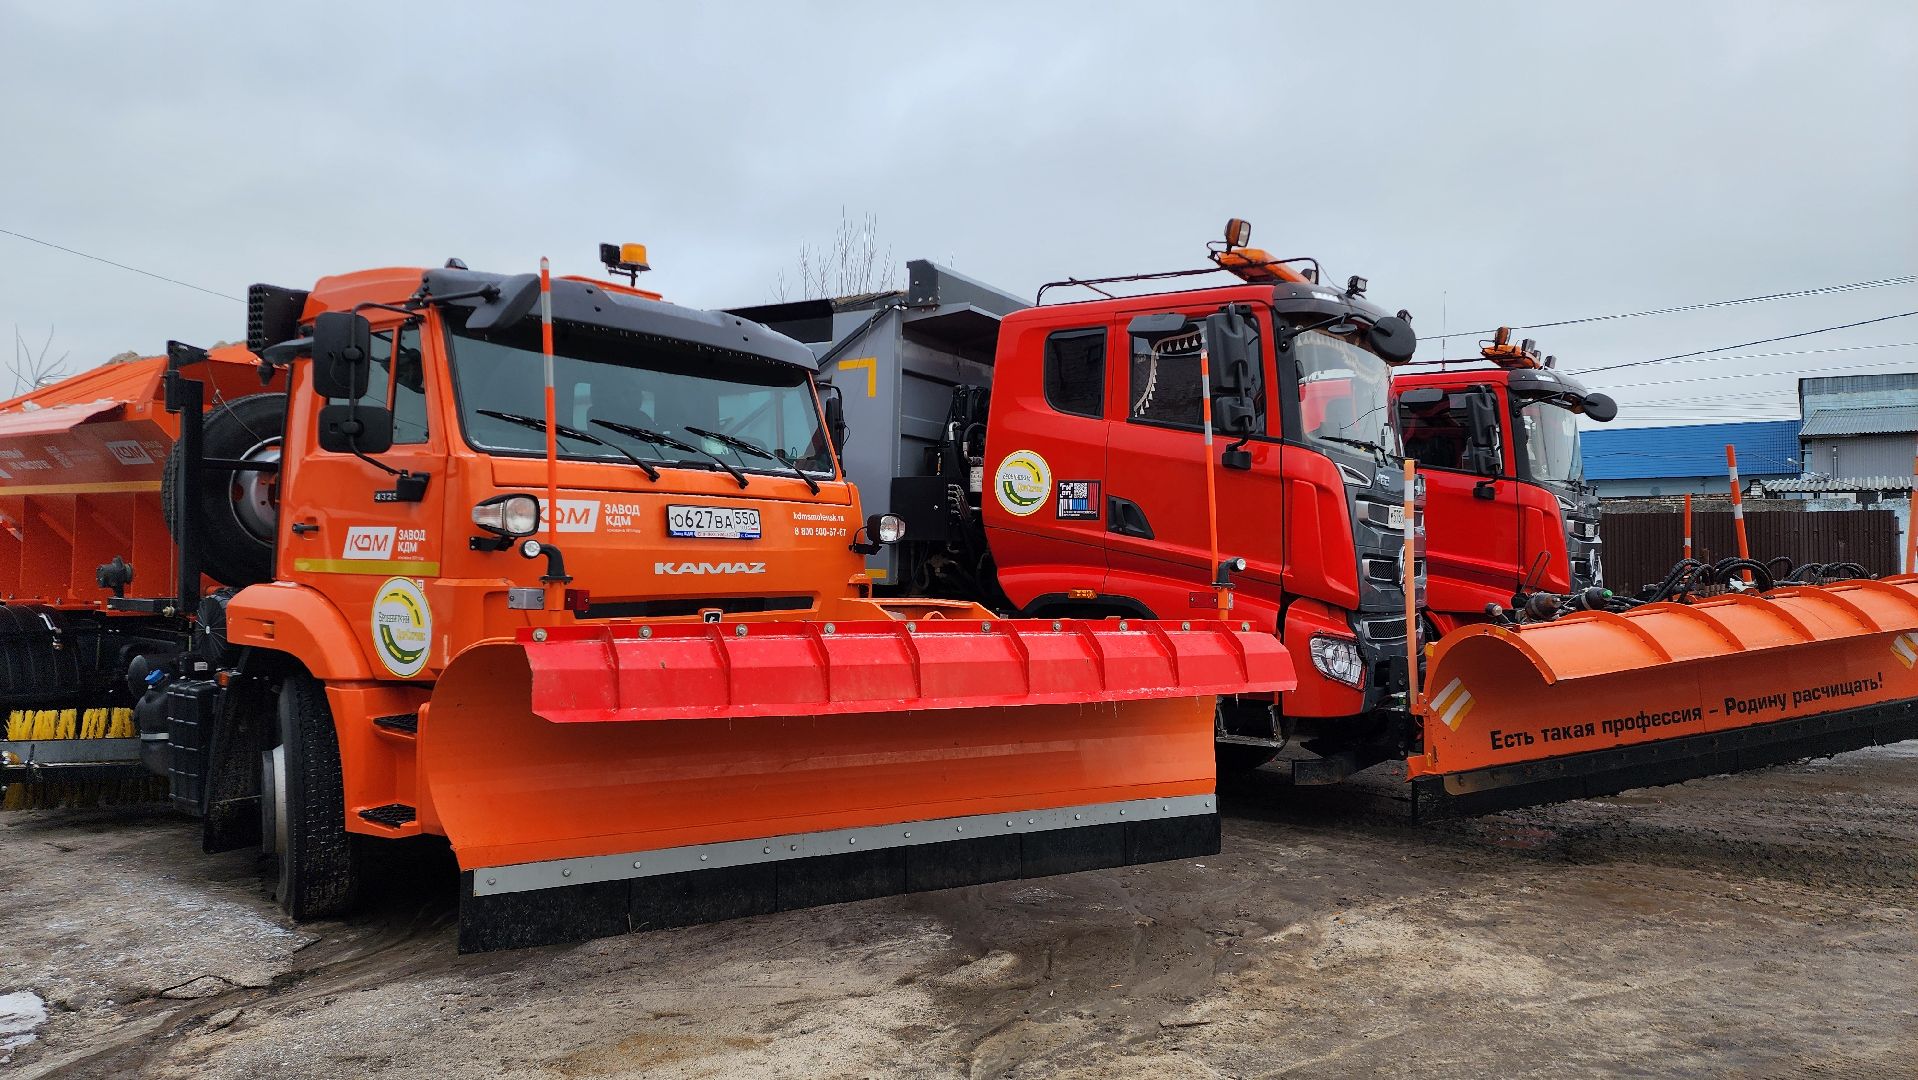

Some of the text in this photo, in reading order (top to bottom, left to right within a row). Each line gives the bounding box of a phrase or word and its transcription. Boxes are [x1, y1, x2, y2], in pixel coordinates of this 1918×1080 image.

[604, 503, 640, 516] ЗАВОД
[605, 515, 631, 528] КДМ
[398, 529, 426, 541] ЗАВОД
[794, 527, 799, 536] 8
[397, 541, 418, 553] КДМ
[654, 562, 766, 575] KAMAZ
[1490, 730, 1534, 750] Есть
[1541, 722, 1595, 742] такая
[1602, 707, 1702, 738] профессия
[1724, 692, 1787, 716] Родину
[1792, 671, 1883, 709] расчищать!
